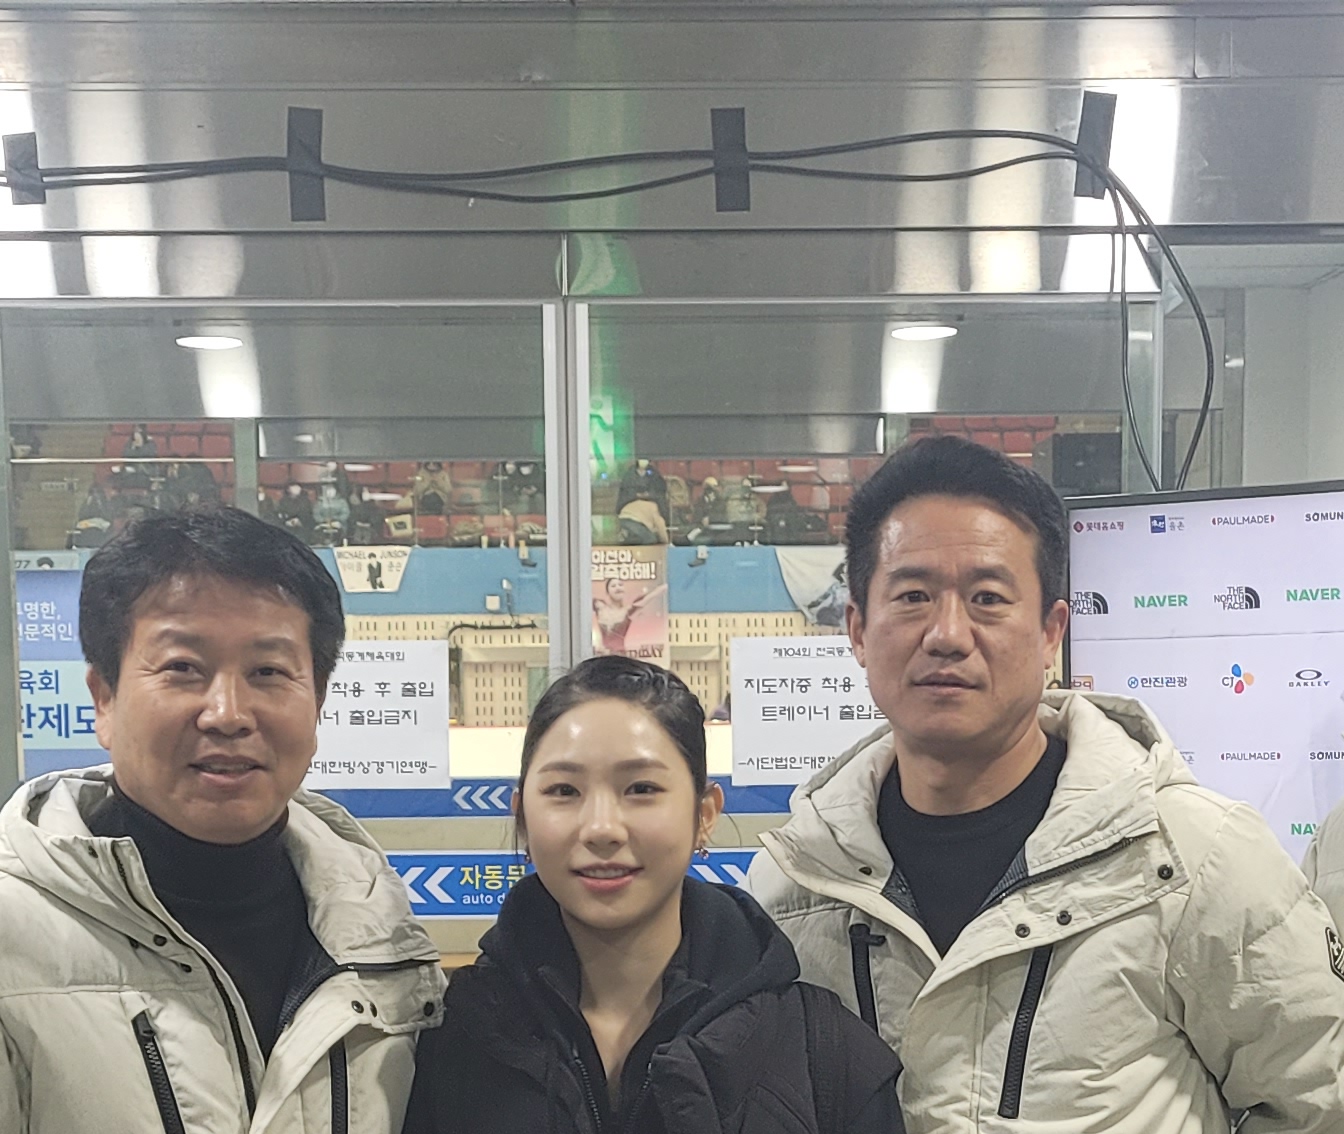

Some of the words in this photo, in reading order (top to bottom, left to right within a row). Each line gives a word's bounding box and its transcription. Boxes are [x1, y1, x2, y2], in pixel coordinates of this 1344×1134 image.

[1086, 521, 1124, 531] 롯데홈쇼핑
[1216, 515, 1270, 526] PAULMADE
[1227, 586, 1244, 594] THE
[1286, 588, 1340, 601] NAVER
[1075, 592, 1092, 600] THE
[1134, 595, 1188, 608] NAVER
[1214, 594, 1244, 603] NORTH
[1072, 607, 1093, 615] FACE
[1223, 602, 1244, 610] FACE
[744, 677, 812, 694] 지도자증
[821, 676, 856, 693] 착용
[1141, 677, 1187, 688] 한진관광
[1222, 676, 1234, 688] CJ
[331, 681, 365, 698] 착용
[374, 682, 391, 698] 후
[400, 682, 434, 698] 출입
[349, 710, 417, 725] 출입금지
[761, 705, 829, 721] 트레이너
[1225, 752, 1276, 761] PAULMADE
[306, 760, 437, 774] 대한빙상경기연맹-
[462, 893, 494, 905] auto
